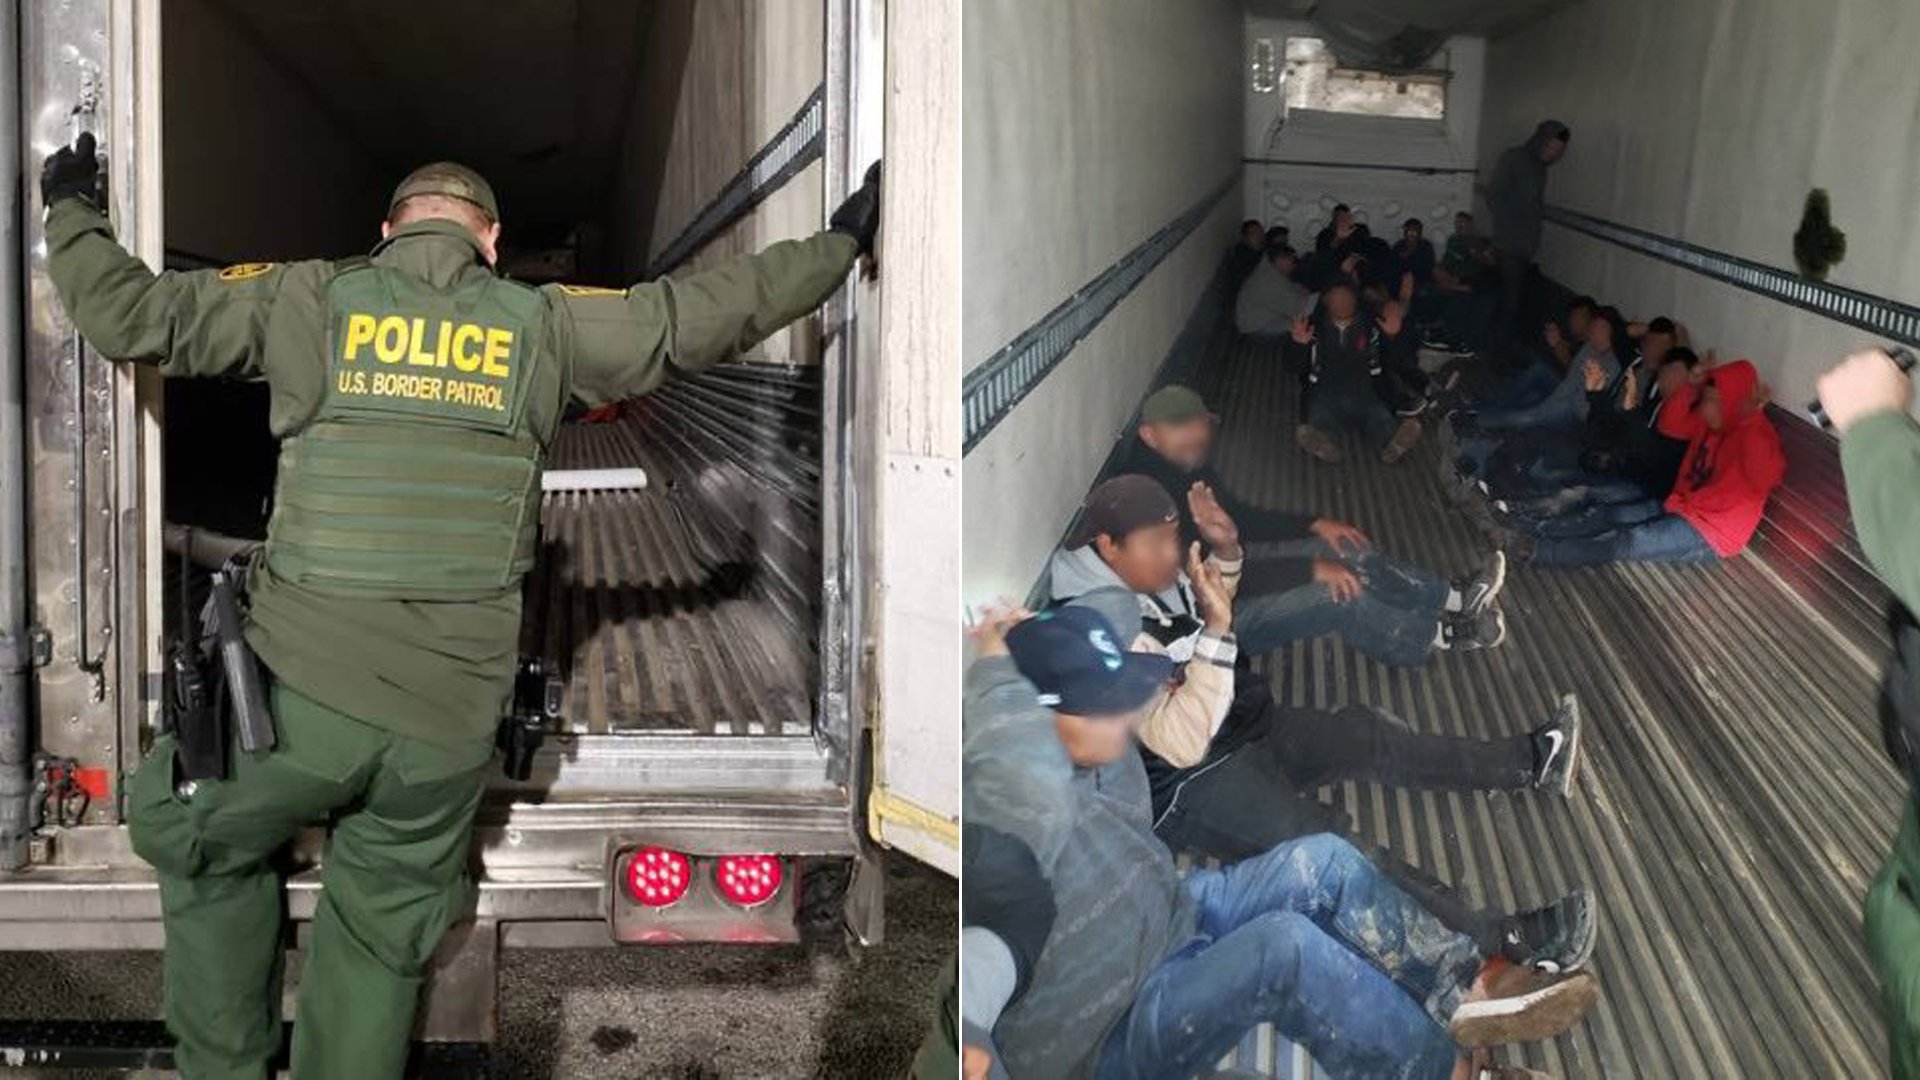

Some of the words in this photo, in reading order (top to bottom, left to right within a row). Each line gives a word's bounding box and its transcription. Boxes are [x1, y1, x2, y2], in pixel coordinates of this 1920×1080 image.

[344, 314, 513, 377] POLICE
[338, 371, 368, 394] U.S.
[372, 372, 441, 400] BORDER
[445, 381, 505, 411] PATROL
